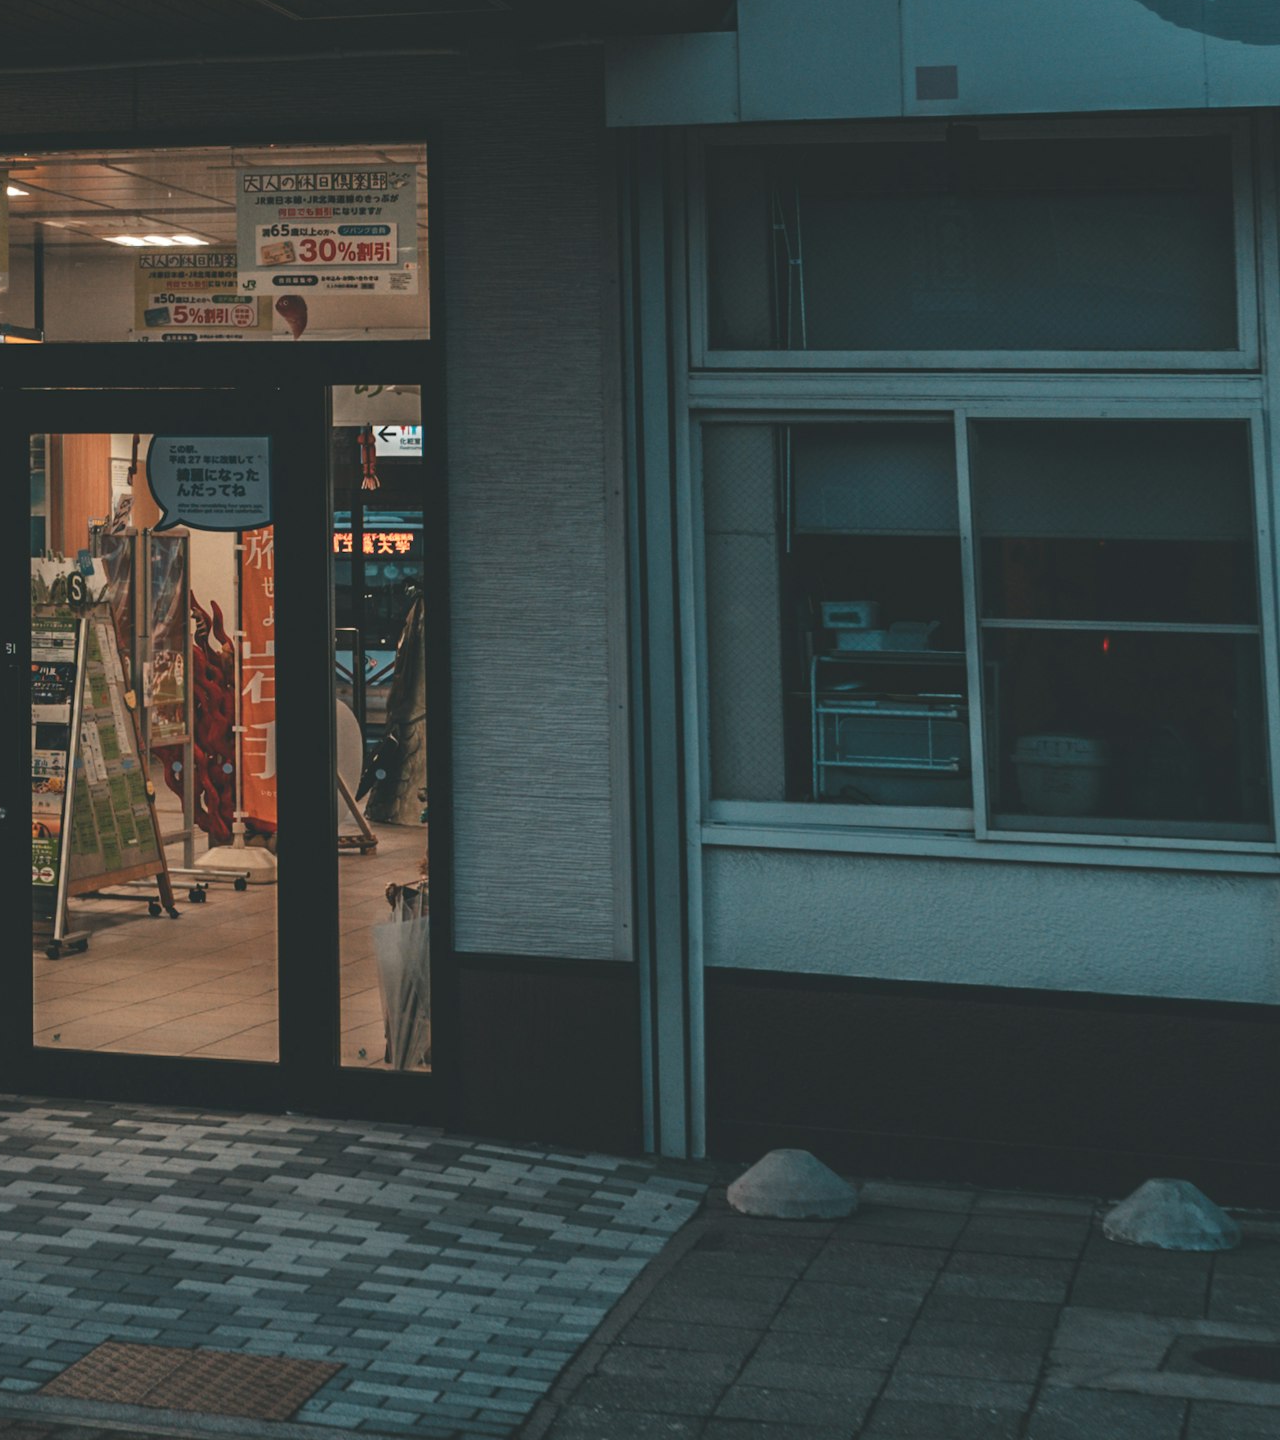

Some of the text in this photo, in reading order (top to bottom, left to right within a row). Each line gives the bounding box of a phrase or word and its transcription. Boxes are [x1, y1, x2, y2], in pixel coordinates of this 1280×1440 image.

[299, 238, 390, 262] 30%割引
[173, 305, 229, 323] 5%割引
[188, 455, 200, 464] 27
[177, 483, 246, 497] んだってね
[5, 642, 16, 654] 引
